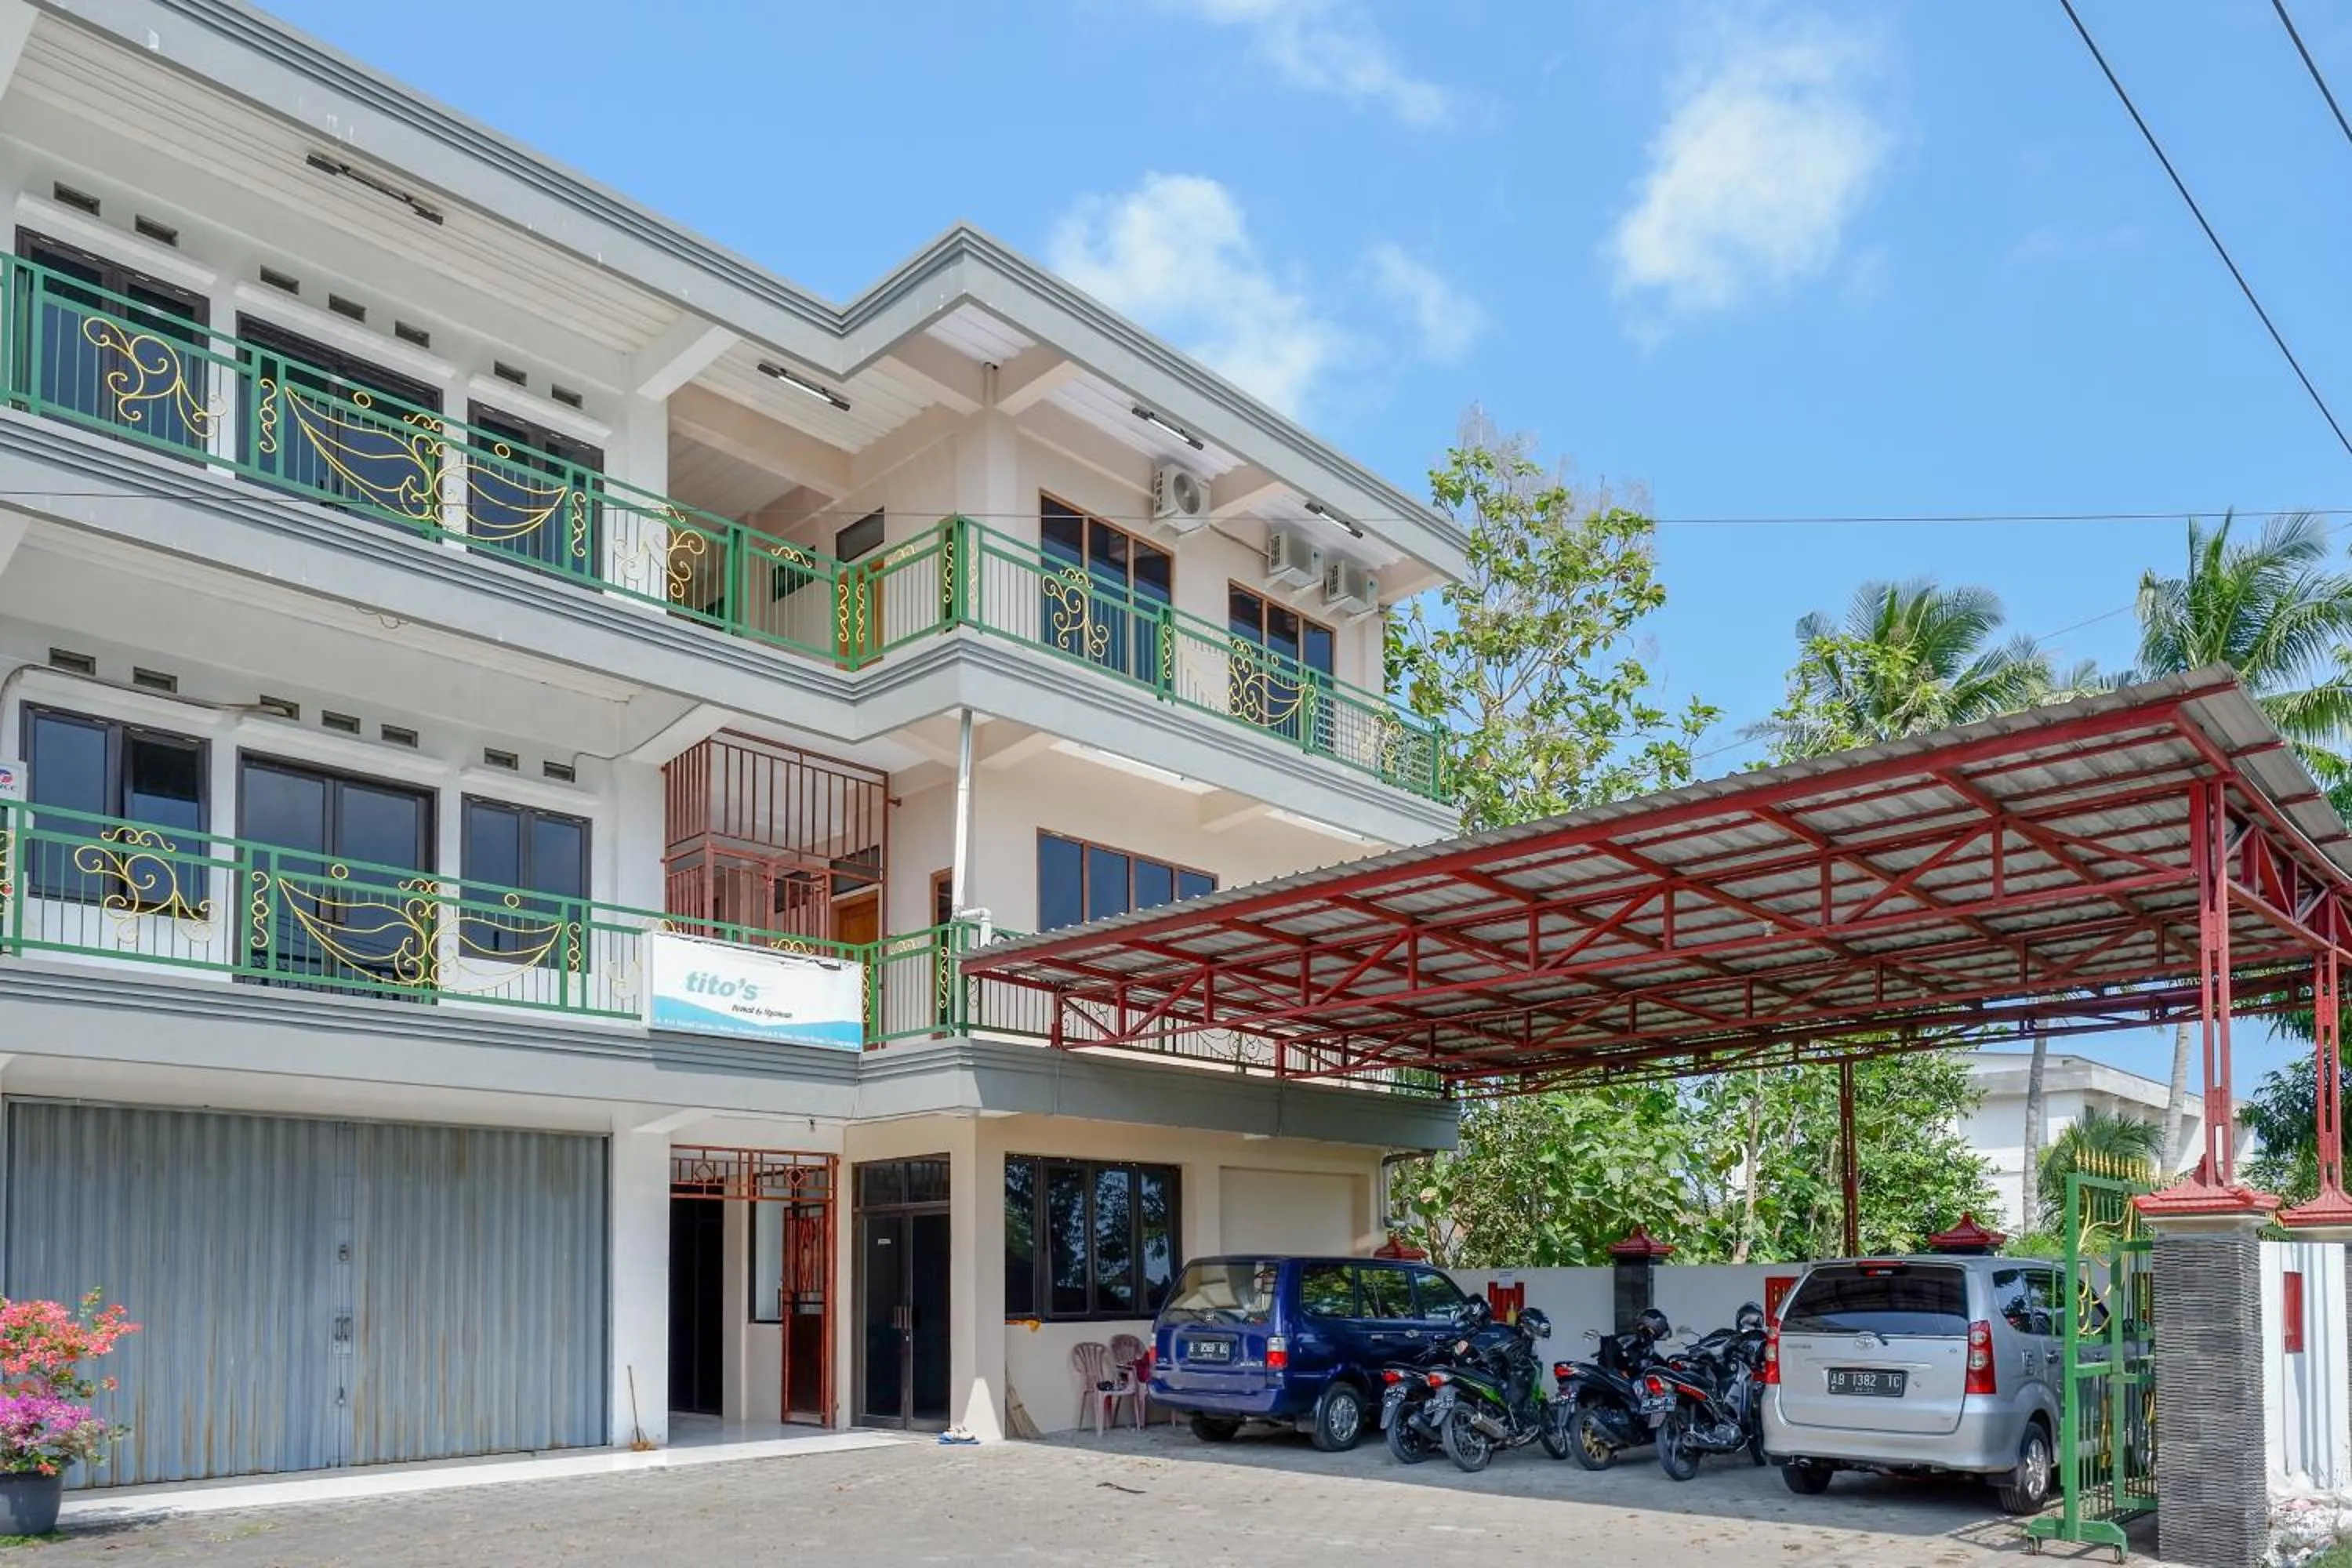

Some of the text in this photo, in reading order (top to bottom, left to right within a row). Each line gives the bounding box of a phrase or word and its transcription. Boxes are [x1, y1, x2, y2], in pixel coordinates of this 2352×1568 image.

[687, 971, 758, 1001] tito's
[1831, 1373, 1845, 1385] AB
[1853, 1374, 1876, 1387] 1382
